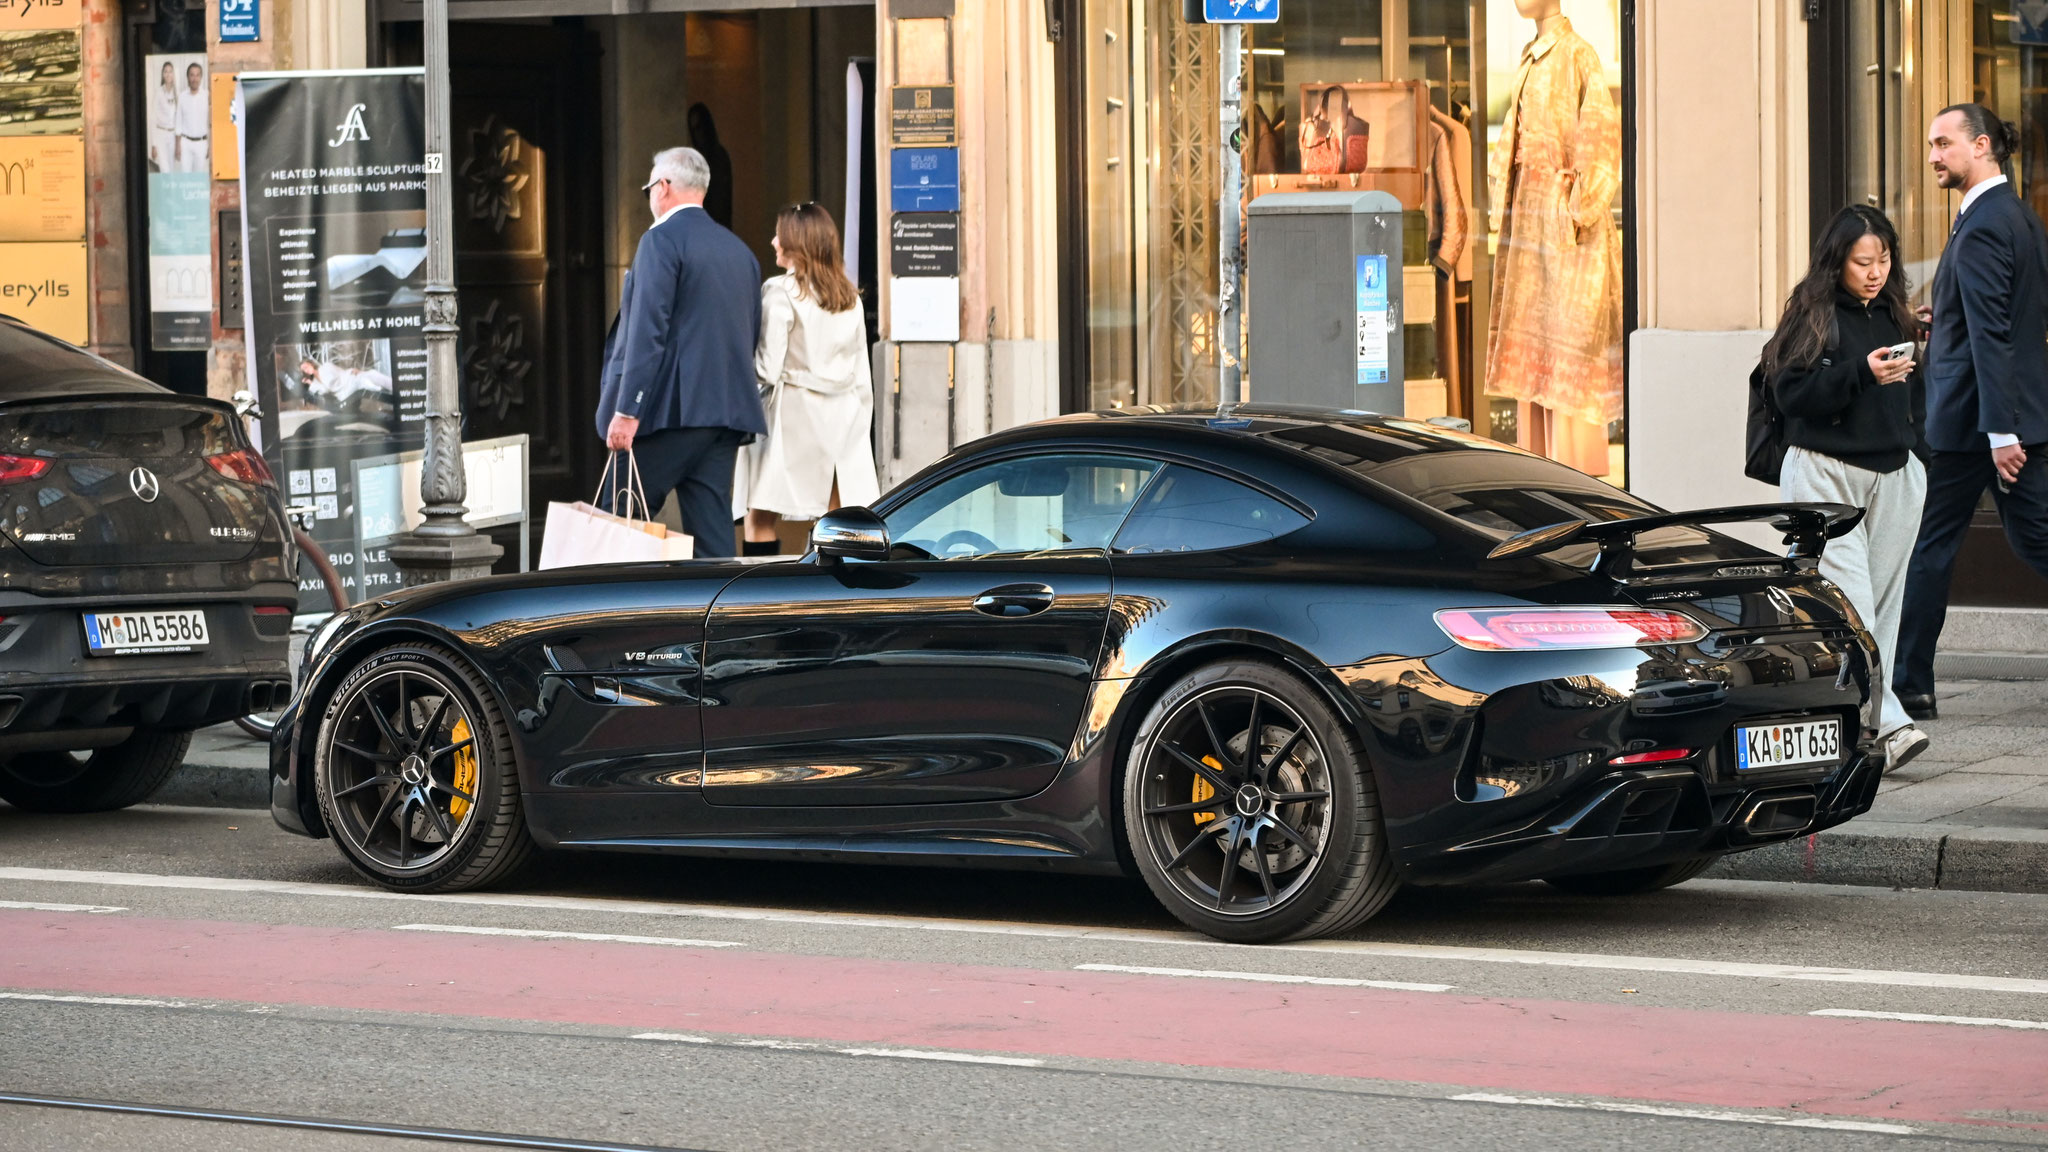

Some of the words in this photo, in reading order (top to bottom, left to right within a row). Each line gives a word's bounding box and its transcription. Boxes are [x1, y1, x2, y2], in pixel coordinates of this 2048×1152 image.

[427, 156, 441, 170] 52
[911, 162, 938, 170] BERGER
[271, 169, 317, 180] HEATED
[320, 166, 364, 178] MARBLE
[366, 164, 426, 176] SCULPTURE
[264, 185, 319, 197] BEHEIZTE
[322, 183, 362, 194] LIEGEN
[365, 182, 386, 192] AUS
[390, 180, 427, 191] MARMO
[279, 228, 316, 237] Experience
[280, 240, 309, 249] ultimate
[282, 268, 298, 277] Visit
[283, 281, 317, 290] showroom
[0, 280, 70, 307] erylls
[283, 293, 306, 302] today!
[299, 319, 365, 333] WELLNESS
[368, 318, 382, 329] AT
[385, 315, 421, 328] HOME
[412, 401, 423, 409] auf
[210, 527, 231, 538] GLE
[98, 617, 115, 645] M
[124, 616, 153, 644] DA
[153, 614, 204, 642] 5586
[624, 652, 646, 661] V8
[646, 653, 683, 661] BITURBO
[334, 659, 379, 704] MICHELIN
[383, 654, 399, 662] PILOT
[1748, 729, 1772, 763] KA
[1782, 726, 1805, 760] BT
[1808, 723, 1838, 757] 633
